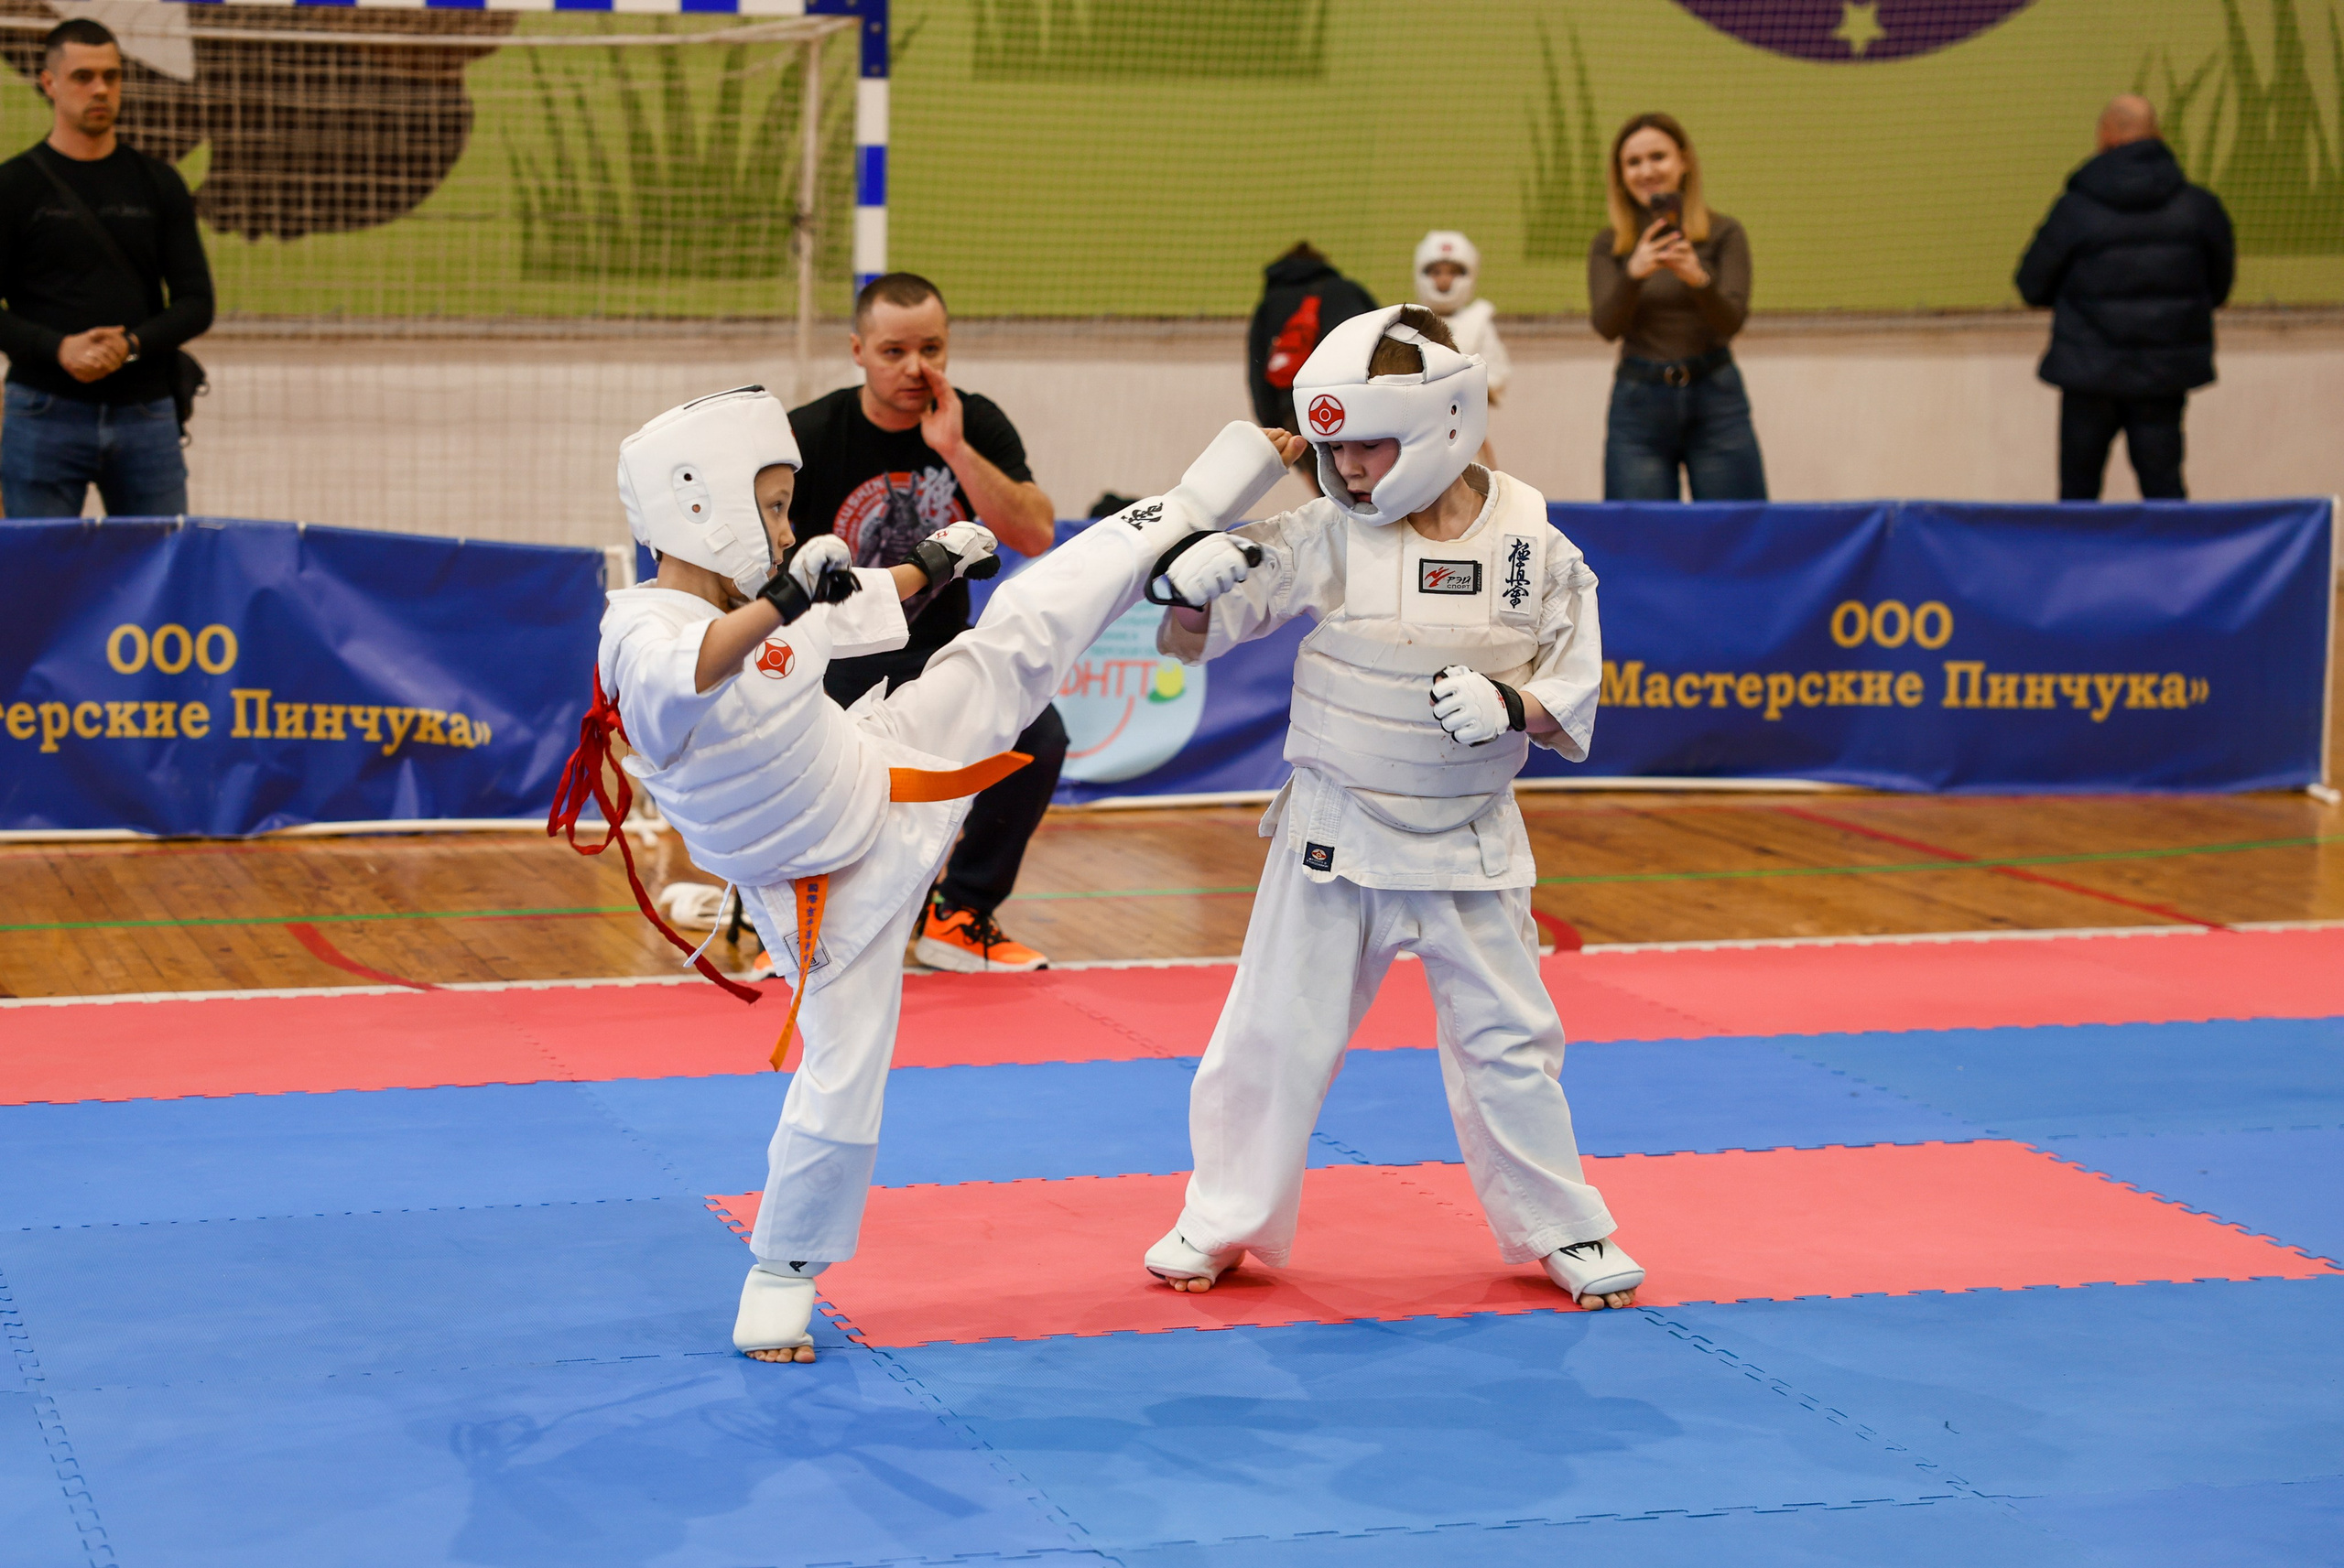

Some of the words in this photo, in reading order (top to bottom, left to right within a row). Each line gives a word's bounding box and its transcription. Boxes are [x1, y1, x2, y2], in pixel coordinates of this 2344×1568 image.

[1447, 575, 1471, 585] РЭЙ
[107, 623, 238, 676] ООО
[1830, 600, 1954, 650] ООО
[1942, 660, 2210, 722] Пинчука»
[0, 701, 210, 753] ерские
[231, 688, 493, 755] Пинчука»
